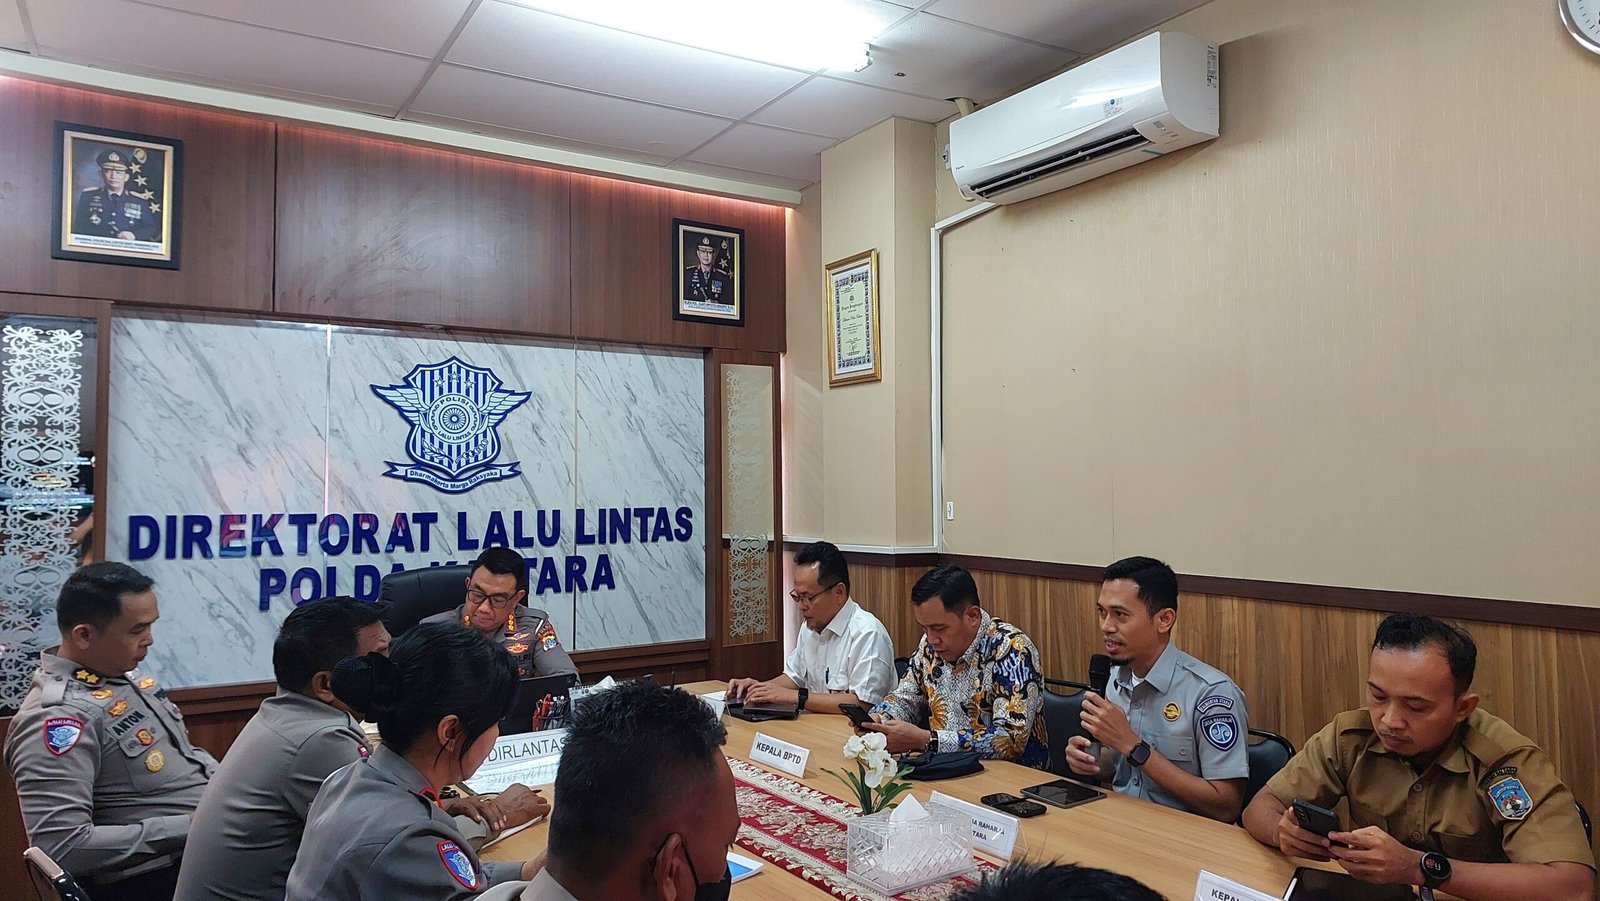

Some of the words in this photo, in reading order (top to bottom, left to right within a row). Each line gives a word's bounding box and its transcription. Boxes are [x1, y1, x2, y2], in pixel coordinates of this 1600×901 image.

[440, 396, 469, 407] POLISI
[438, 430, 452, 440] LALU
[452, 431, 472, 441] LINTAS
[410, 471, 449, 488] Dharmakerta
[449, 481, 469, 489] Marga
[469, 470, 498, 484] Raksyaka
[128, 512, 438, 561] DIREKTORAT
[457, 508, 561, 551] LALU
[575, 505, 694, 545] LINTAS
[259, 562, 406, 612] POLD
[111, 710, 146, 736] ANTON
[756, 741, 782, 758] KEPALA
[782, 751, 802, 765] BPTD
